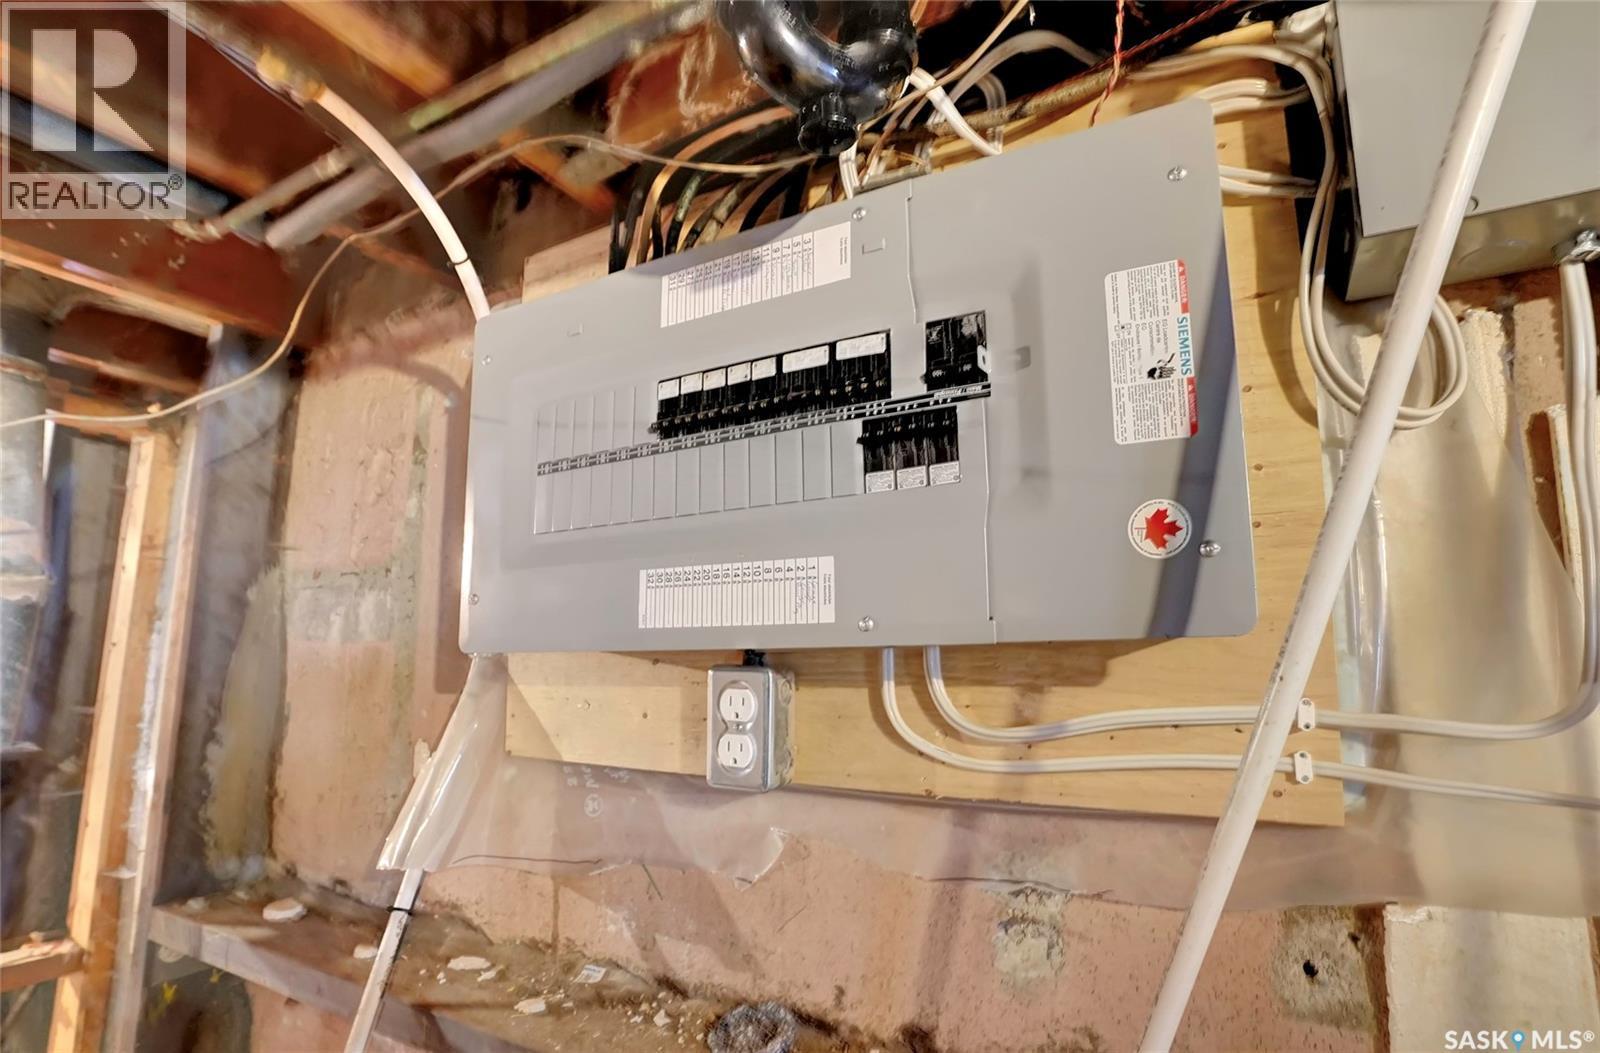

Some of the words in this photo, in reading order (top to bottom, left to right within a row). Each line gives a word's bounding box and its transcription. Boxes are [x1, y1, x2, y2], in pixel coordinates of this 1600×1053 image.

[1177, 316, 1192, 376] SIEMENS
[684, 570, 691, 582] 24
[694, 570, 701, 581] 22
[703, 569, 710, 581] 20
[713, 568, 720, 579] 18
[723, 567, 730, 579] 16
[733, 567, 740, 578] 14
[743, 566, 750, 577] 12
[754, 565, 761, 576] 10
[647, 572, 654, 584] 32
[656, 572, 663, 583] 30
[665, 572, 672, 583] 28
[675, 571, 682, 582] 26
